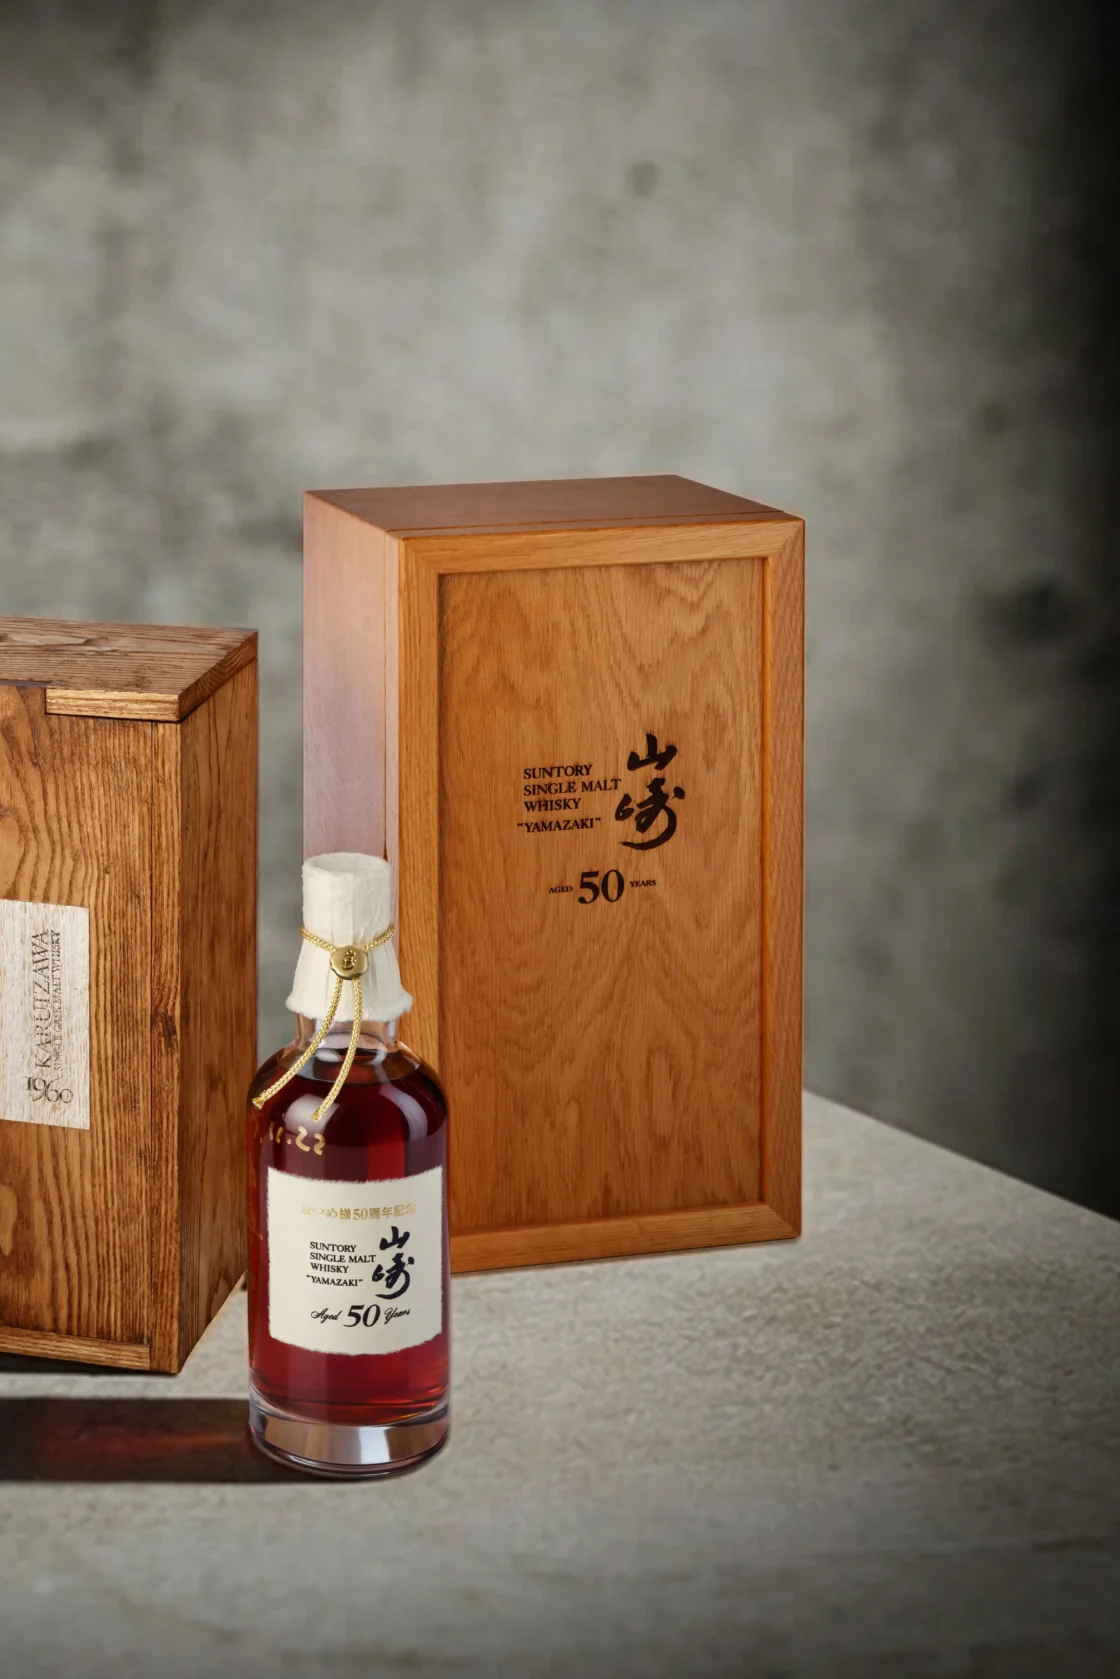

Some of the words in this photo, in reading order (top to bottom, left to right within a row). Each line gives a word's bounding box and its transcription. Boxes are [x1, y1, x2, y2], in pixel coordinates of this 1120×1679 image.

[523, 764, 593, 780] SUNTORY
[523, 781, 577, 797] SINGLE
[581, 778, 622, 793] MALT
[523, 798, 582, 813] WHISKY
[548, 885, 574, 895] AGED
[577, 869, 625, 904] 50
[630, 878, 657, 888] YEARS
[32, 928, 51, 1069] KARUIZAWA
[25, 1077, 74, 1104] 1960
[309, 1241, 357, 1253] SUNTORY
[309, 1251, 346, 1264] SINGLE
[348, 1254, 376, 1264] MALT
[310, 1262, 349, 1274] WHISKY
[310, 1308, 342, 1324] Aged
[343, 1303, 381, 1328] 50
[384, 1307, 411, 1325] Years
